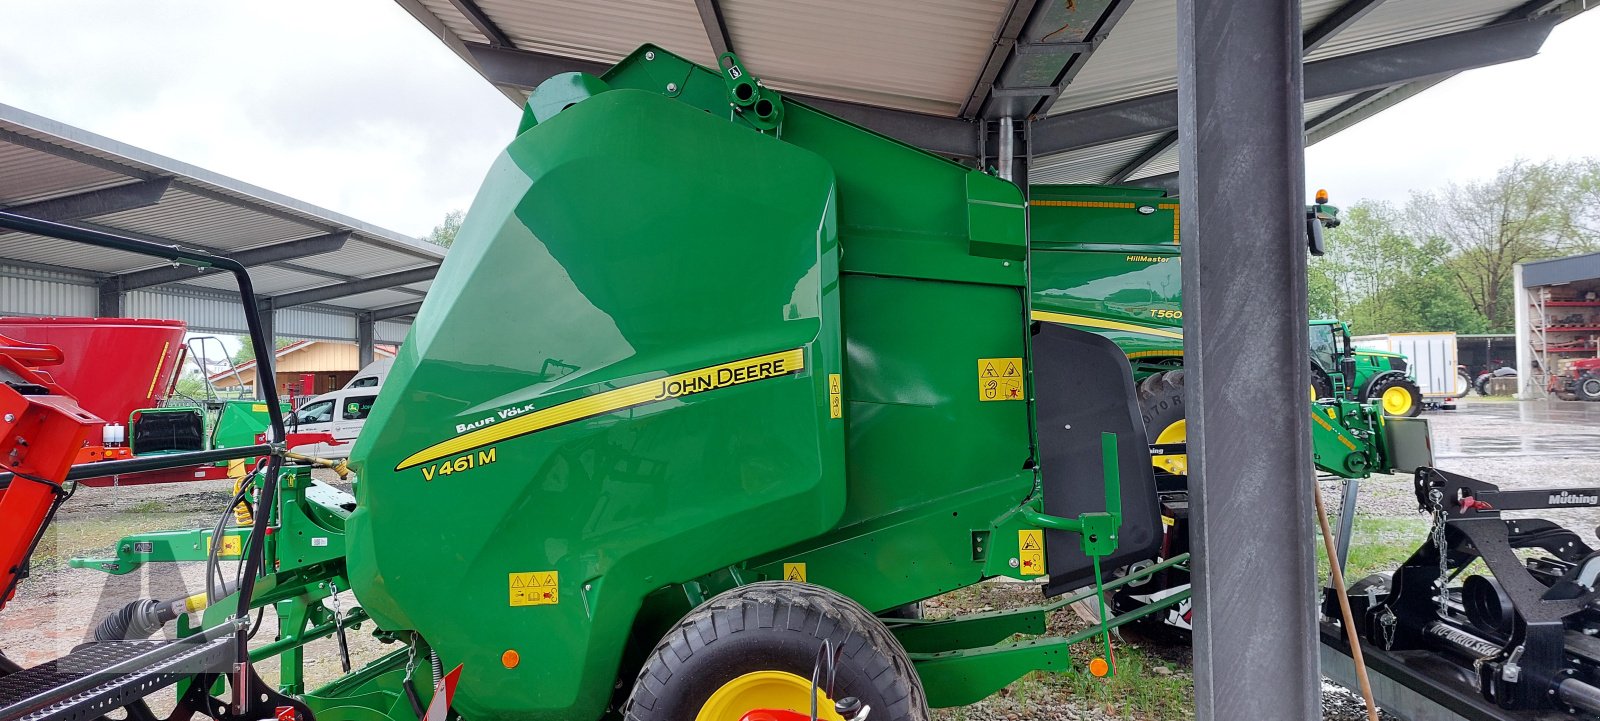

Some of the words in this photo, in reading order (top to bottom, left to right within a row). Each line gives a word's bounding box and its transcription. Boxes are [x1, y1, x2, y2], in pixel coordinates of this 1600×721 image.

[1126, 255, 1170, 263] HillMaster
[654, 375, 712, 399] JOHN
[717, 359, 785, 385] DEERE
[455, 416, 496, 434] BAUR
[1548, 491, 1598, 505] Müthing
